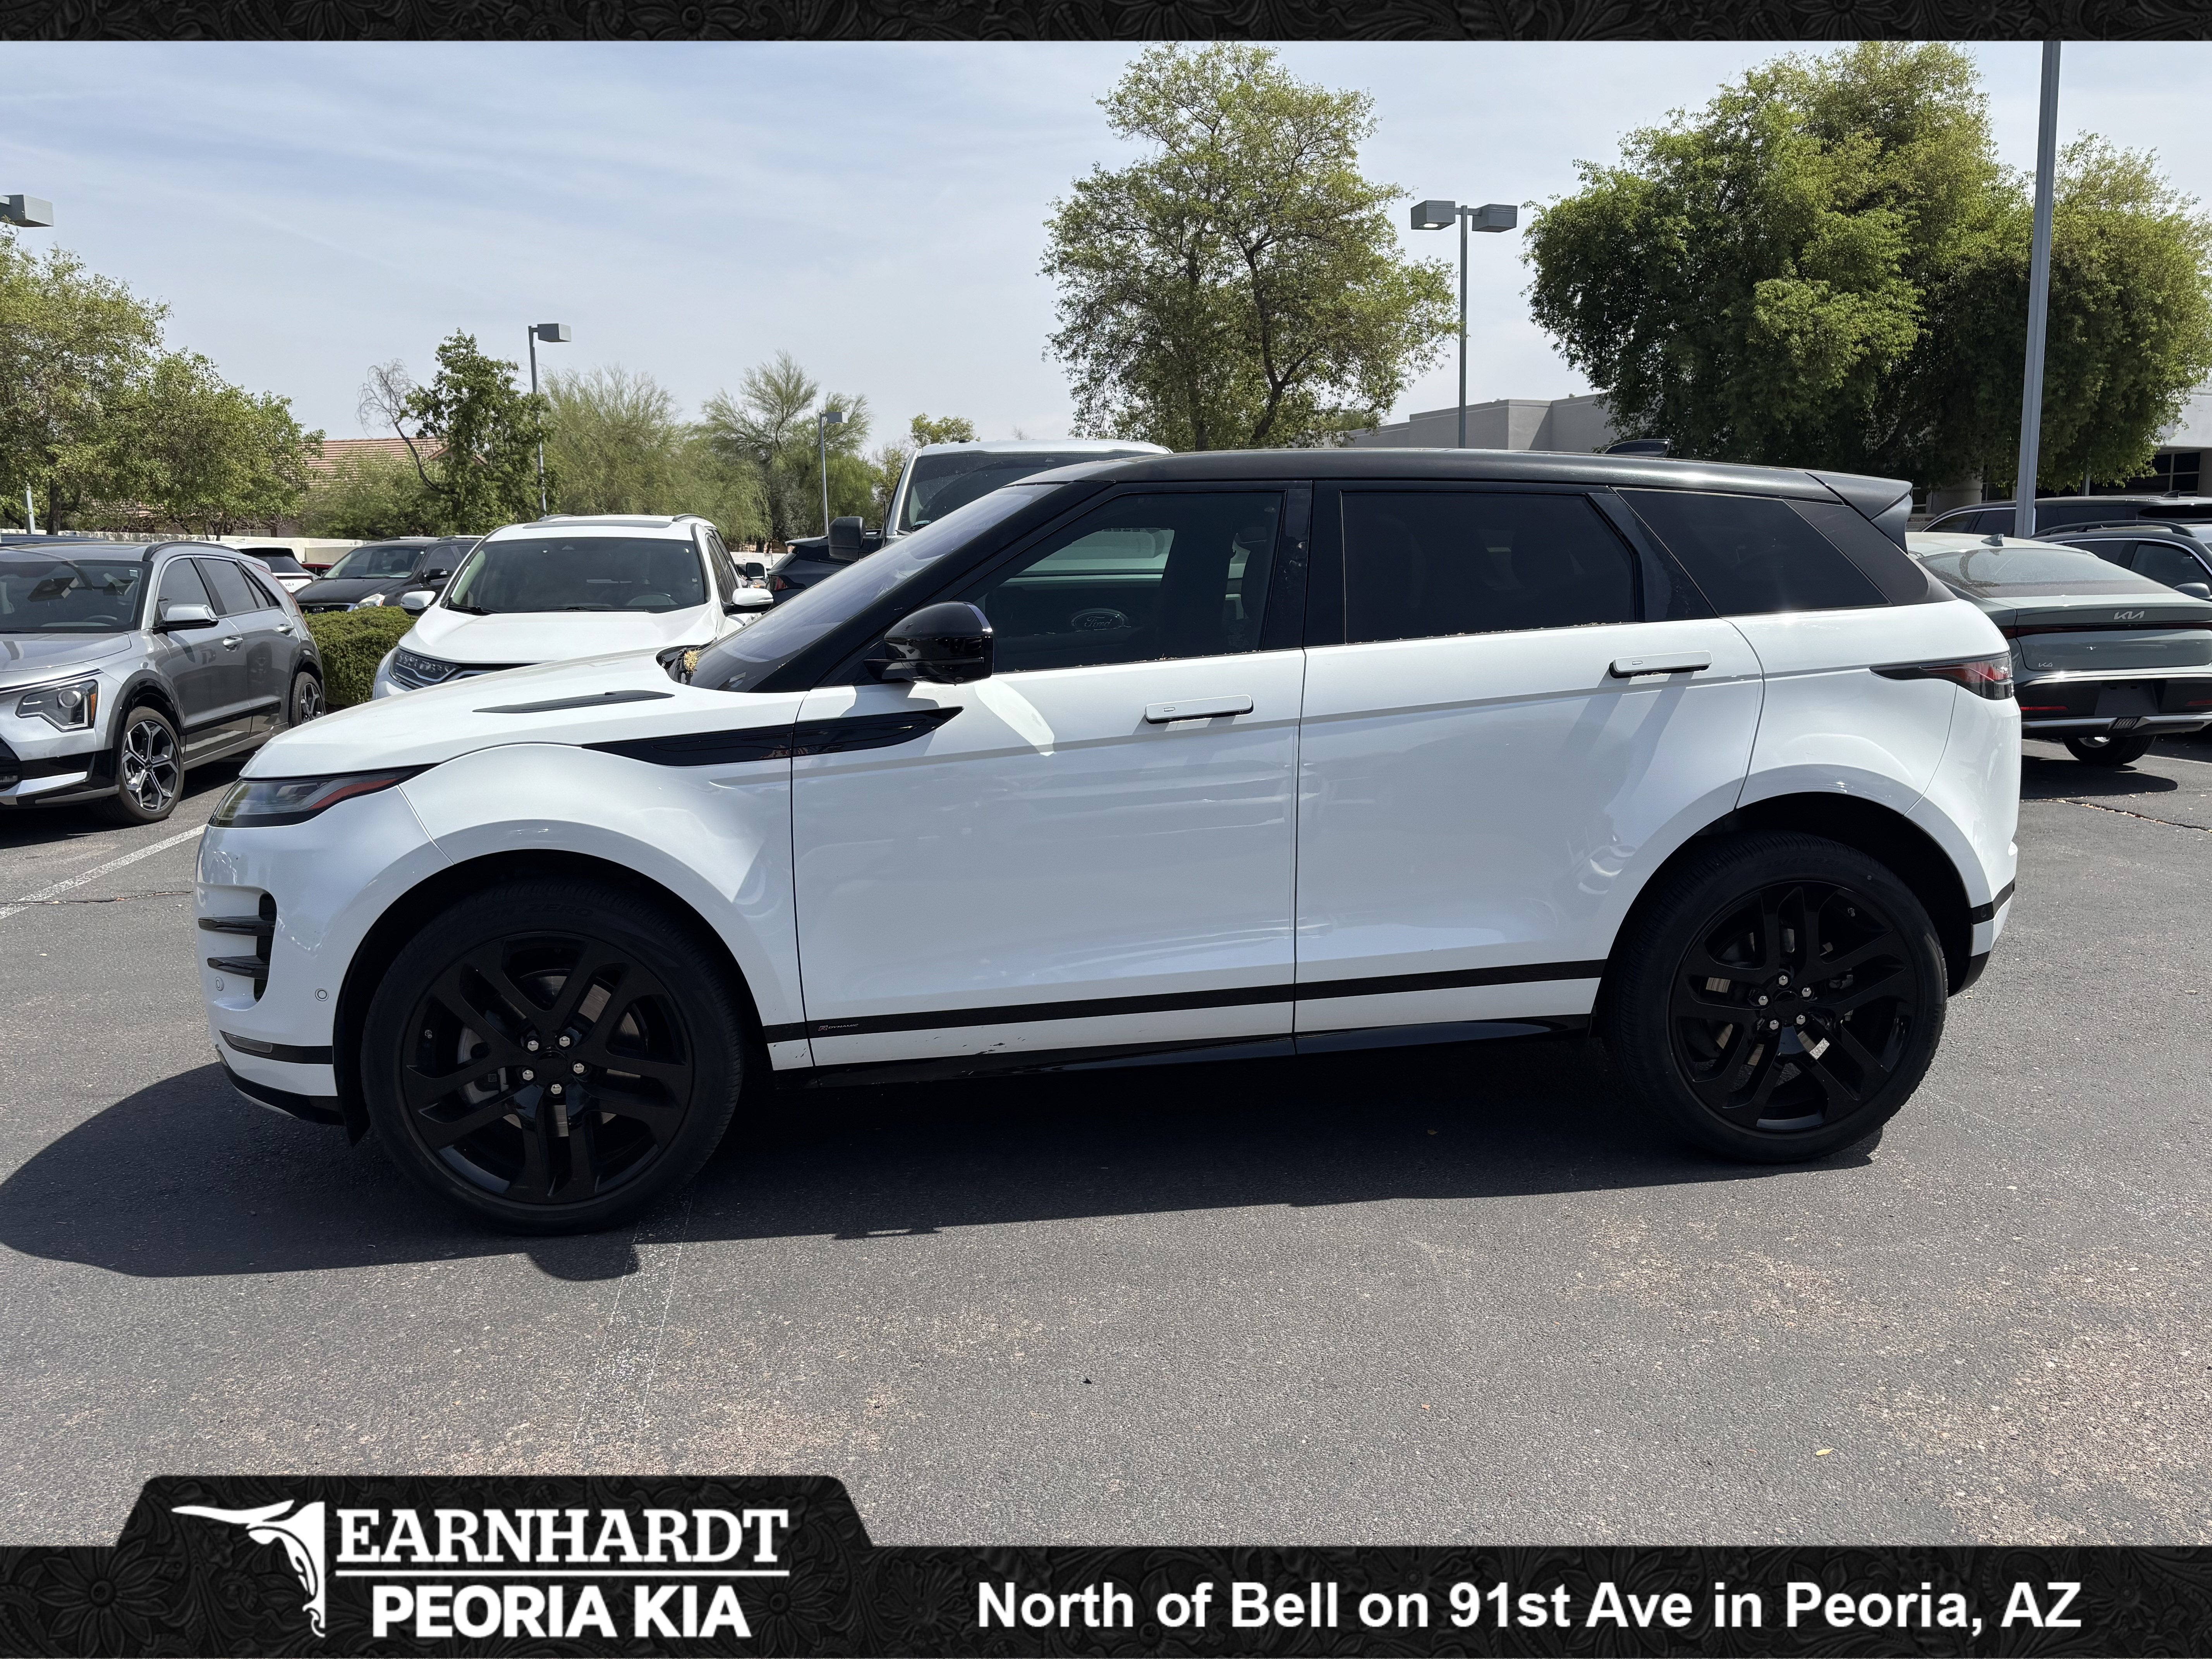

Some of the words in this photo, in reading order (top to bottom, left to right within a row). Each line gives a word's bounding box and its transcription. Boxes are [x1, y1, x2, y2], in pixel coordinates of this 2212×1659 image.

[2114, 611, 2145, 620] KIA
[1084, 616, 1112, 627] Ford
[525, 903, 594, 919] ZERO
